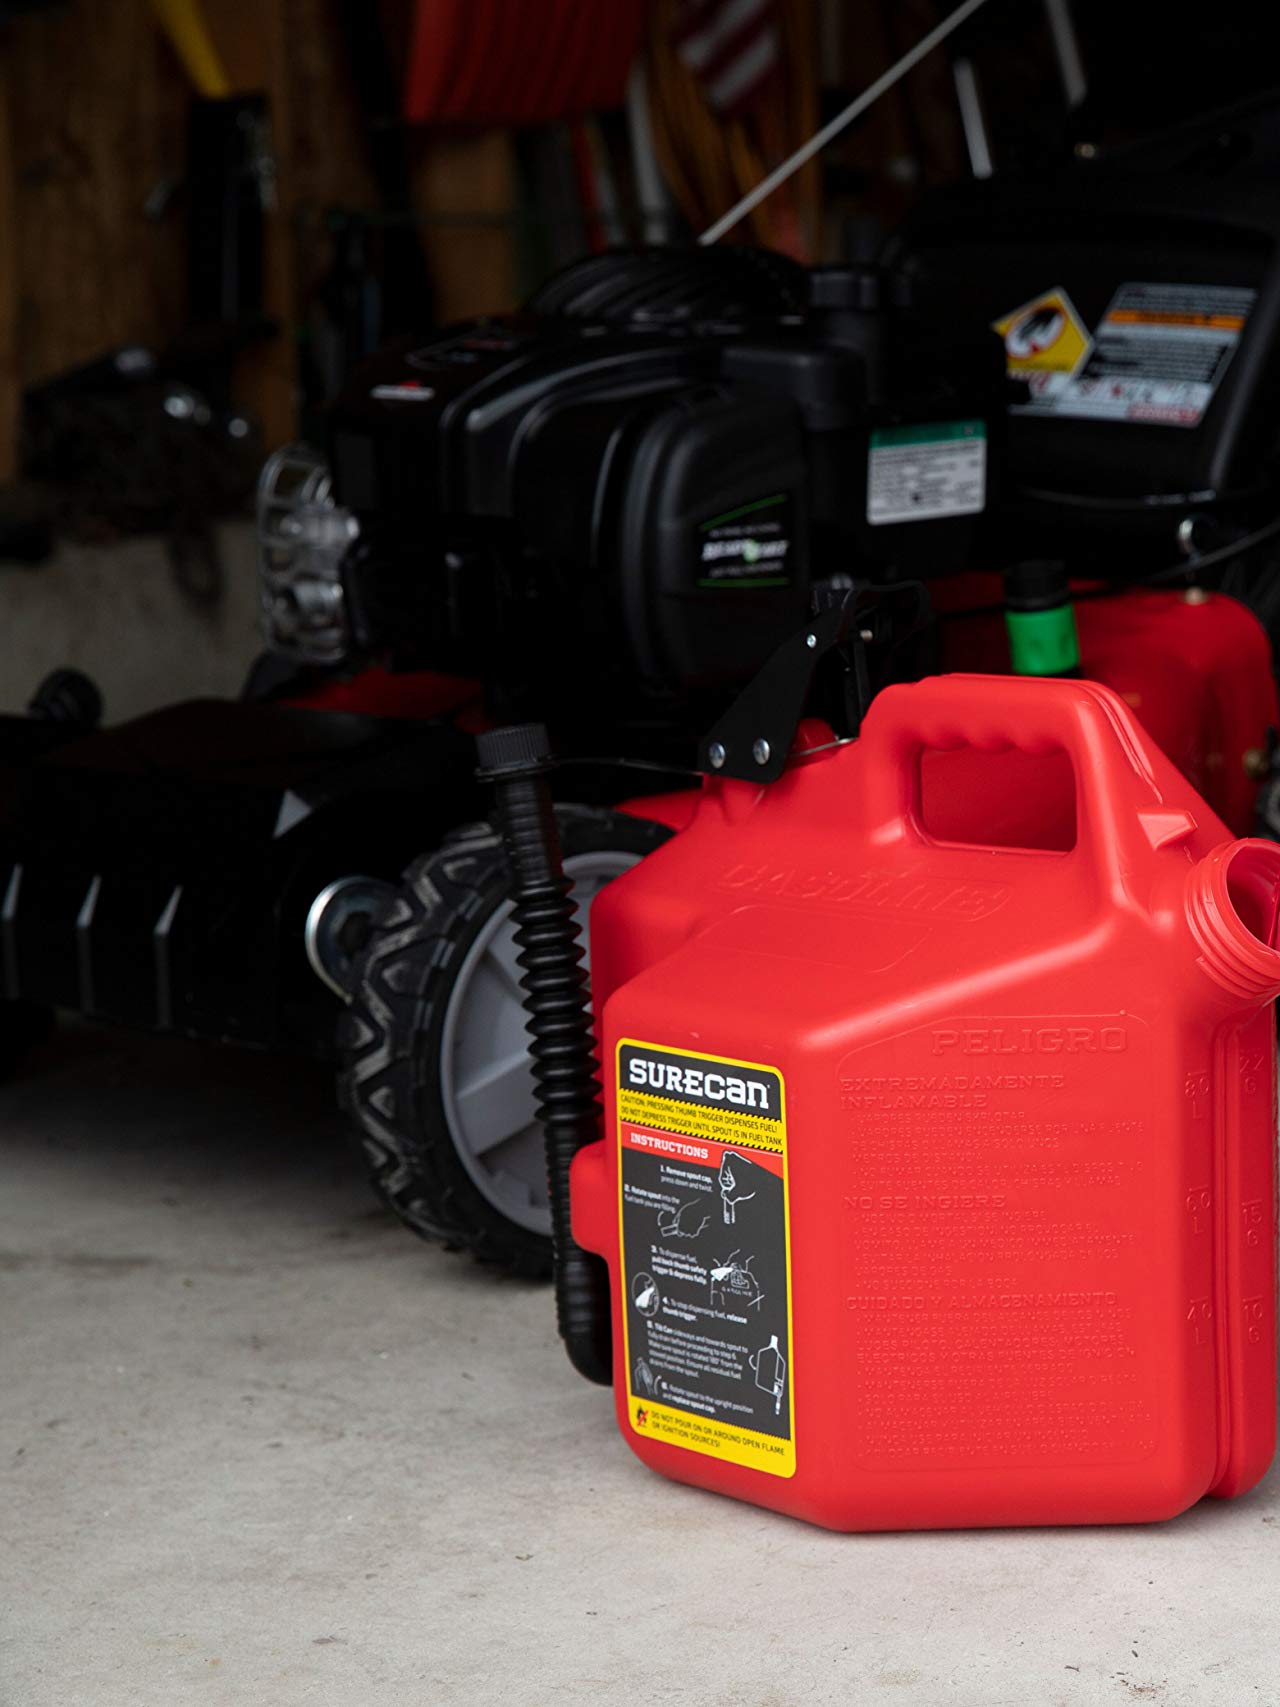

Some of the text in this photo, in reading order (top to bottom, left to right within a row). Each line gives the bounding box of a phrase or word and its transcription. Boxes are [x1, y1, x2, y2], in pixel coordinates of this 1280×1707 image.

[931, 1027, 1129, 1056] PELIGRO
[840, 1094, 988, 1110] INFLAMABLE
[621, 1106, 629, 1114] DO
[630, 1108, 641, 1117] NOT
[668, 1116, 692, 1129] TRIGGER
[694, 1121, 710, 1132] UNTIL
[713, 1125, 732, 1136] SPOUT
[734, 1129, 739, 1138] IS
[741, 1131, 748, 1140] IN
[750, 1132, 764, 1143] FUEL
[766, 1136, 782, 1146] TANK
[676, 1106, 696, 1117] THUMB
[699, 1110, 723, 1122] TRIGGER
[725, 1116, 758, 1129] DISPENSES
[760, 1122, 777, 1133] FUEL!
[631, 1133, 708, 1159] INSTRUCTIONS
[651, 1411, 784, 1456] DO NOT POUR ON OR AROUND OPEN FLAME
[652, 1421, 720, 1448] OR IGNITION SOURCES!
